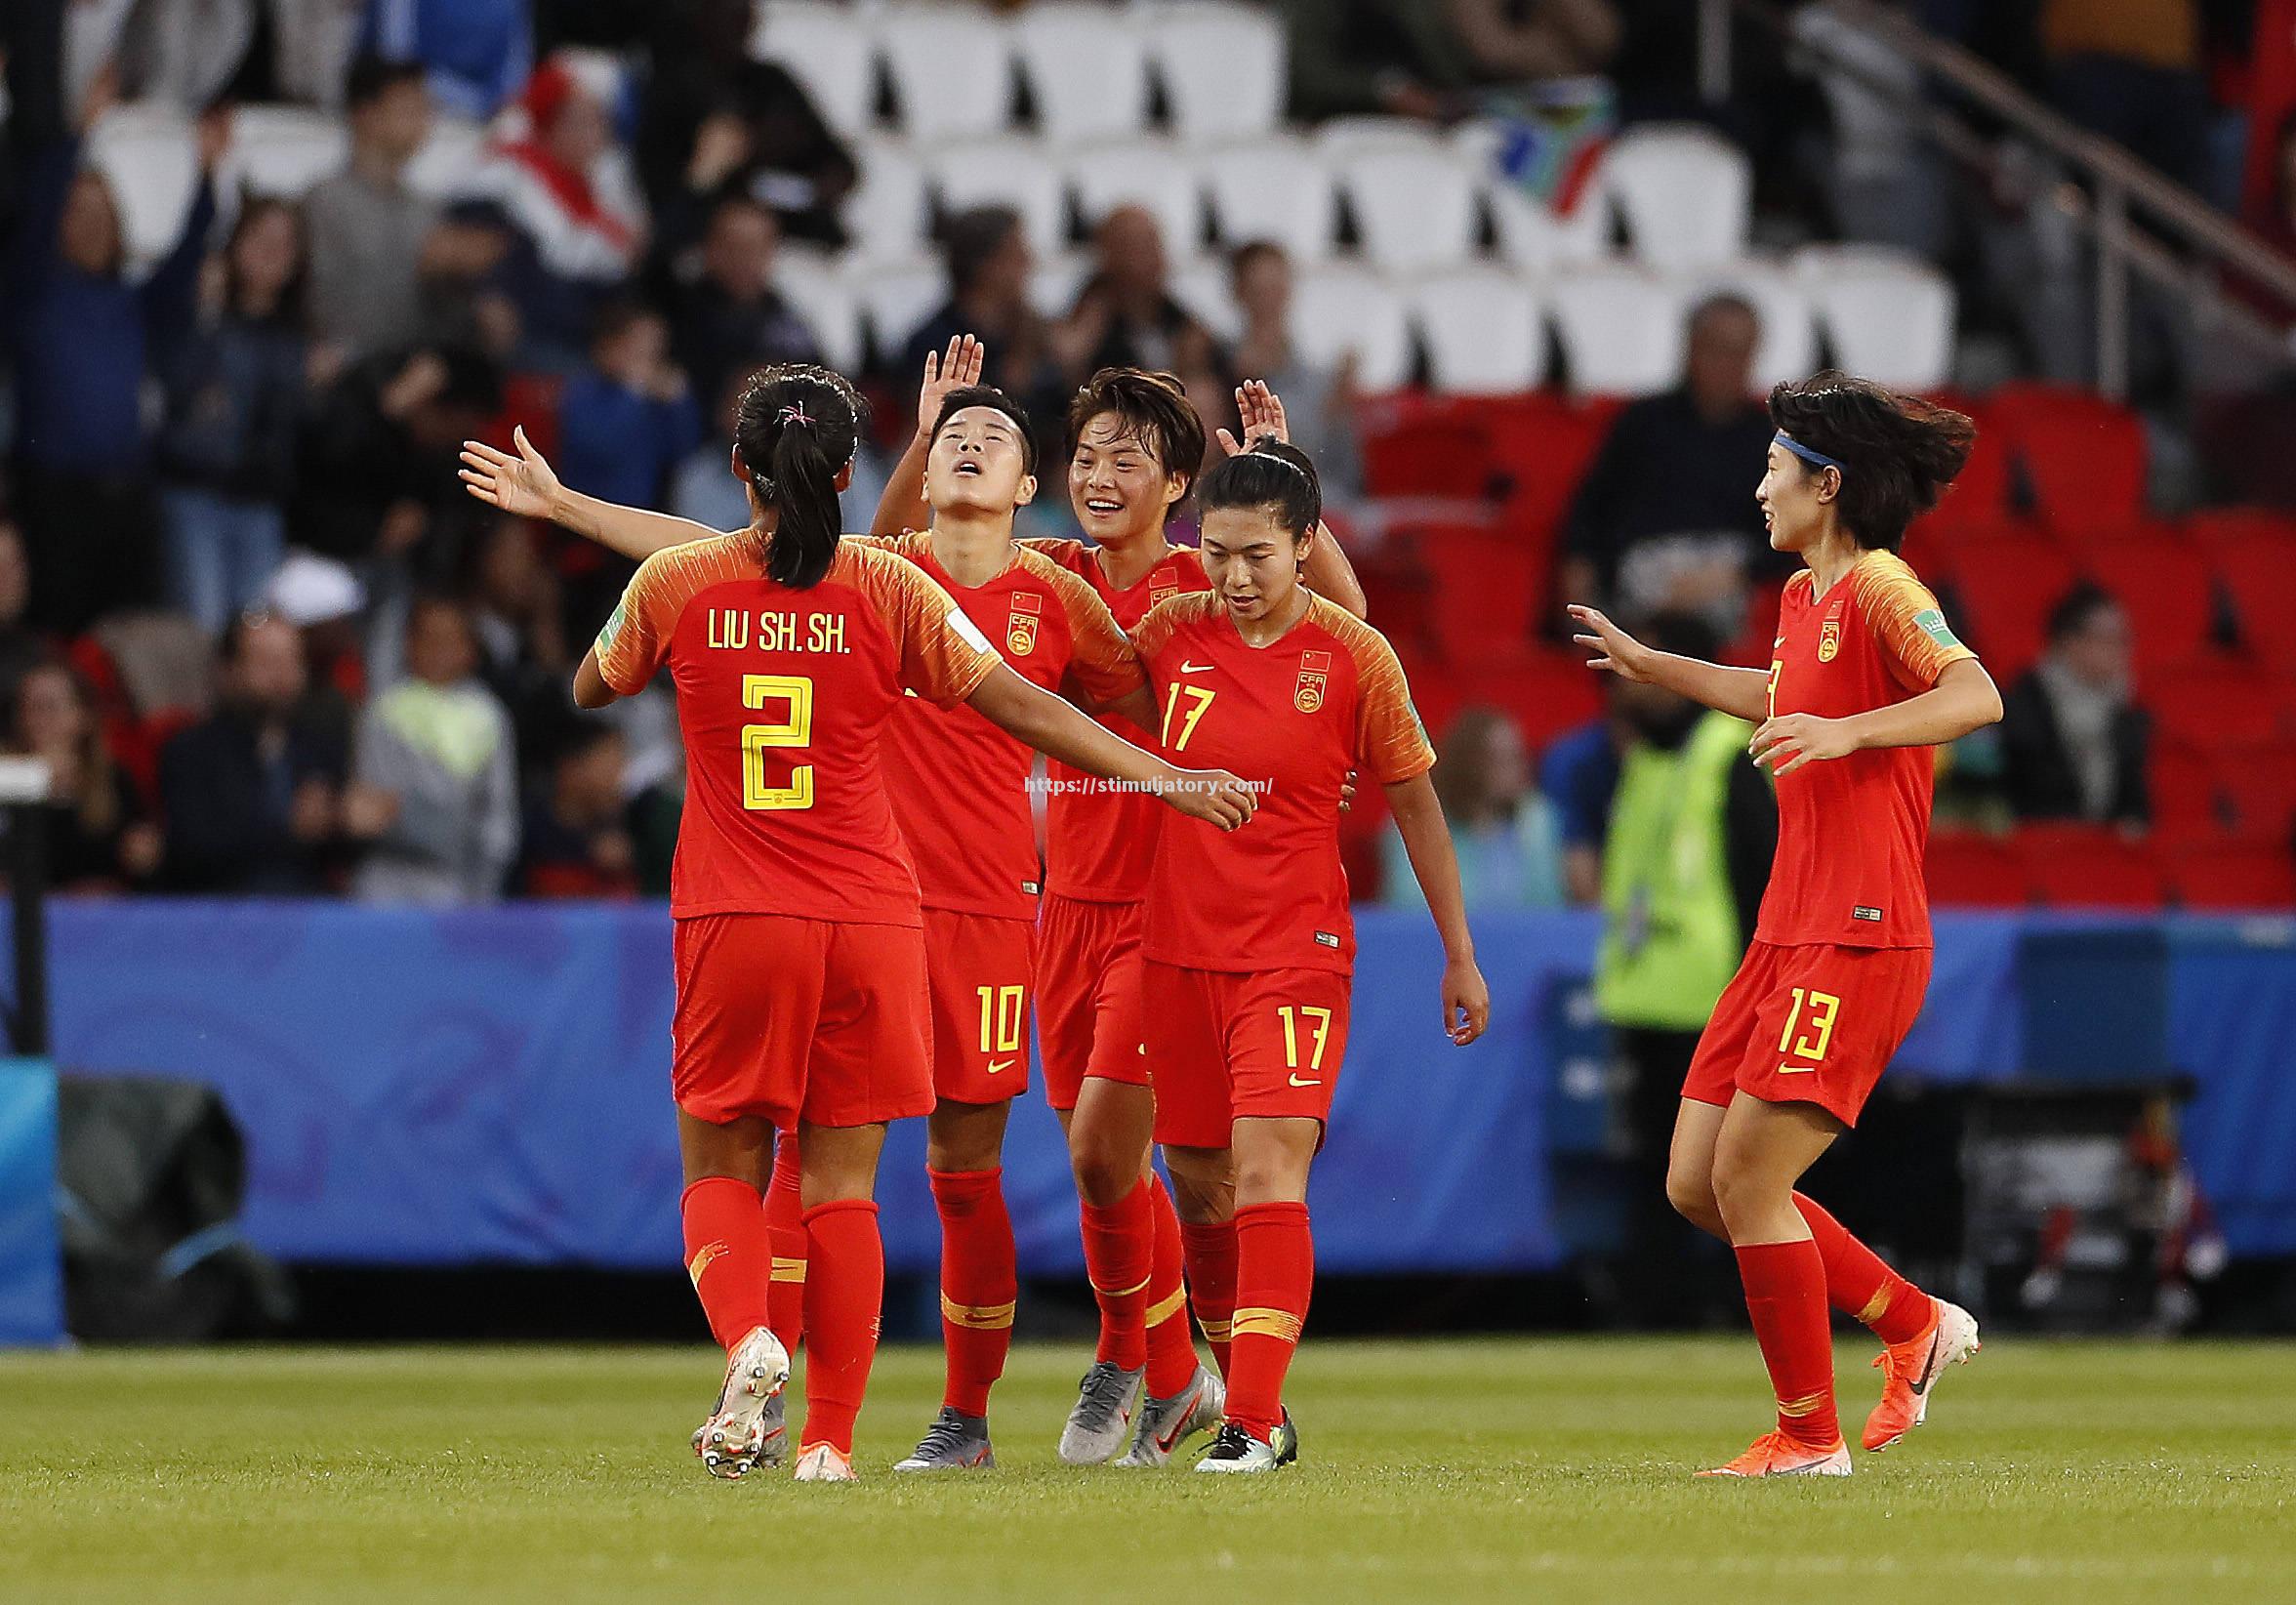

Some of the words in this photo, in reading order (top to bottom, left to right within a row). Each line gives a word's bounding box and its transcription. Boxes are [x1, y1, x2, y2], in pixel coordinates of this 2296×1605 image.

[708, 608, 749, 649] LIU
[1011, 615, 1036, 628] CFA
[1299, 674, 1324, 684] CFA
[741, 674, 814, 810] 2
[1161, 681, 1216, 751] 17
[977, 985, 1024, 1052] 10
[1277, 1006, 1332, 1070] 17
[1779, 987, 1840, 1061] 13
